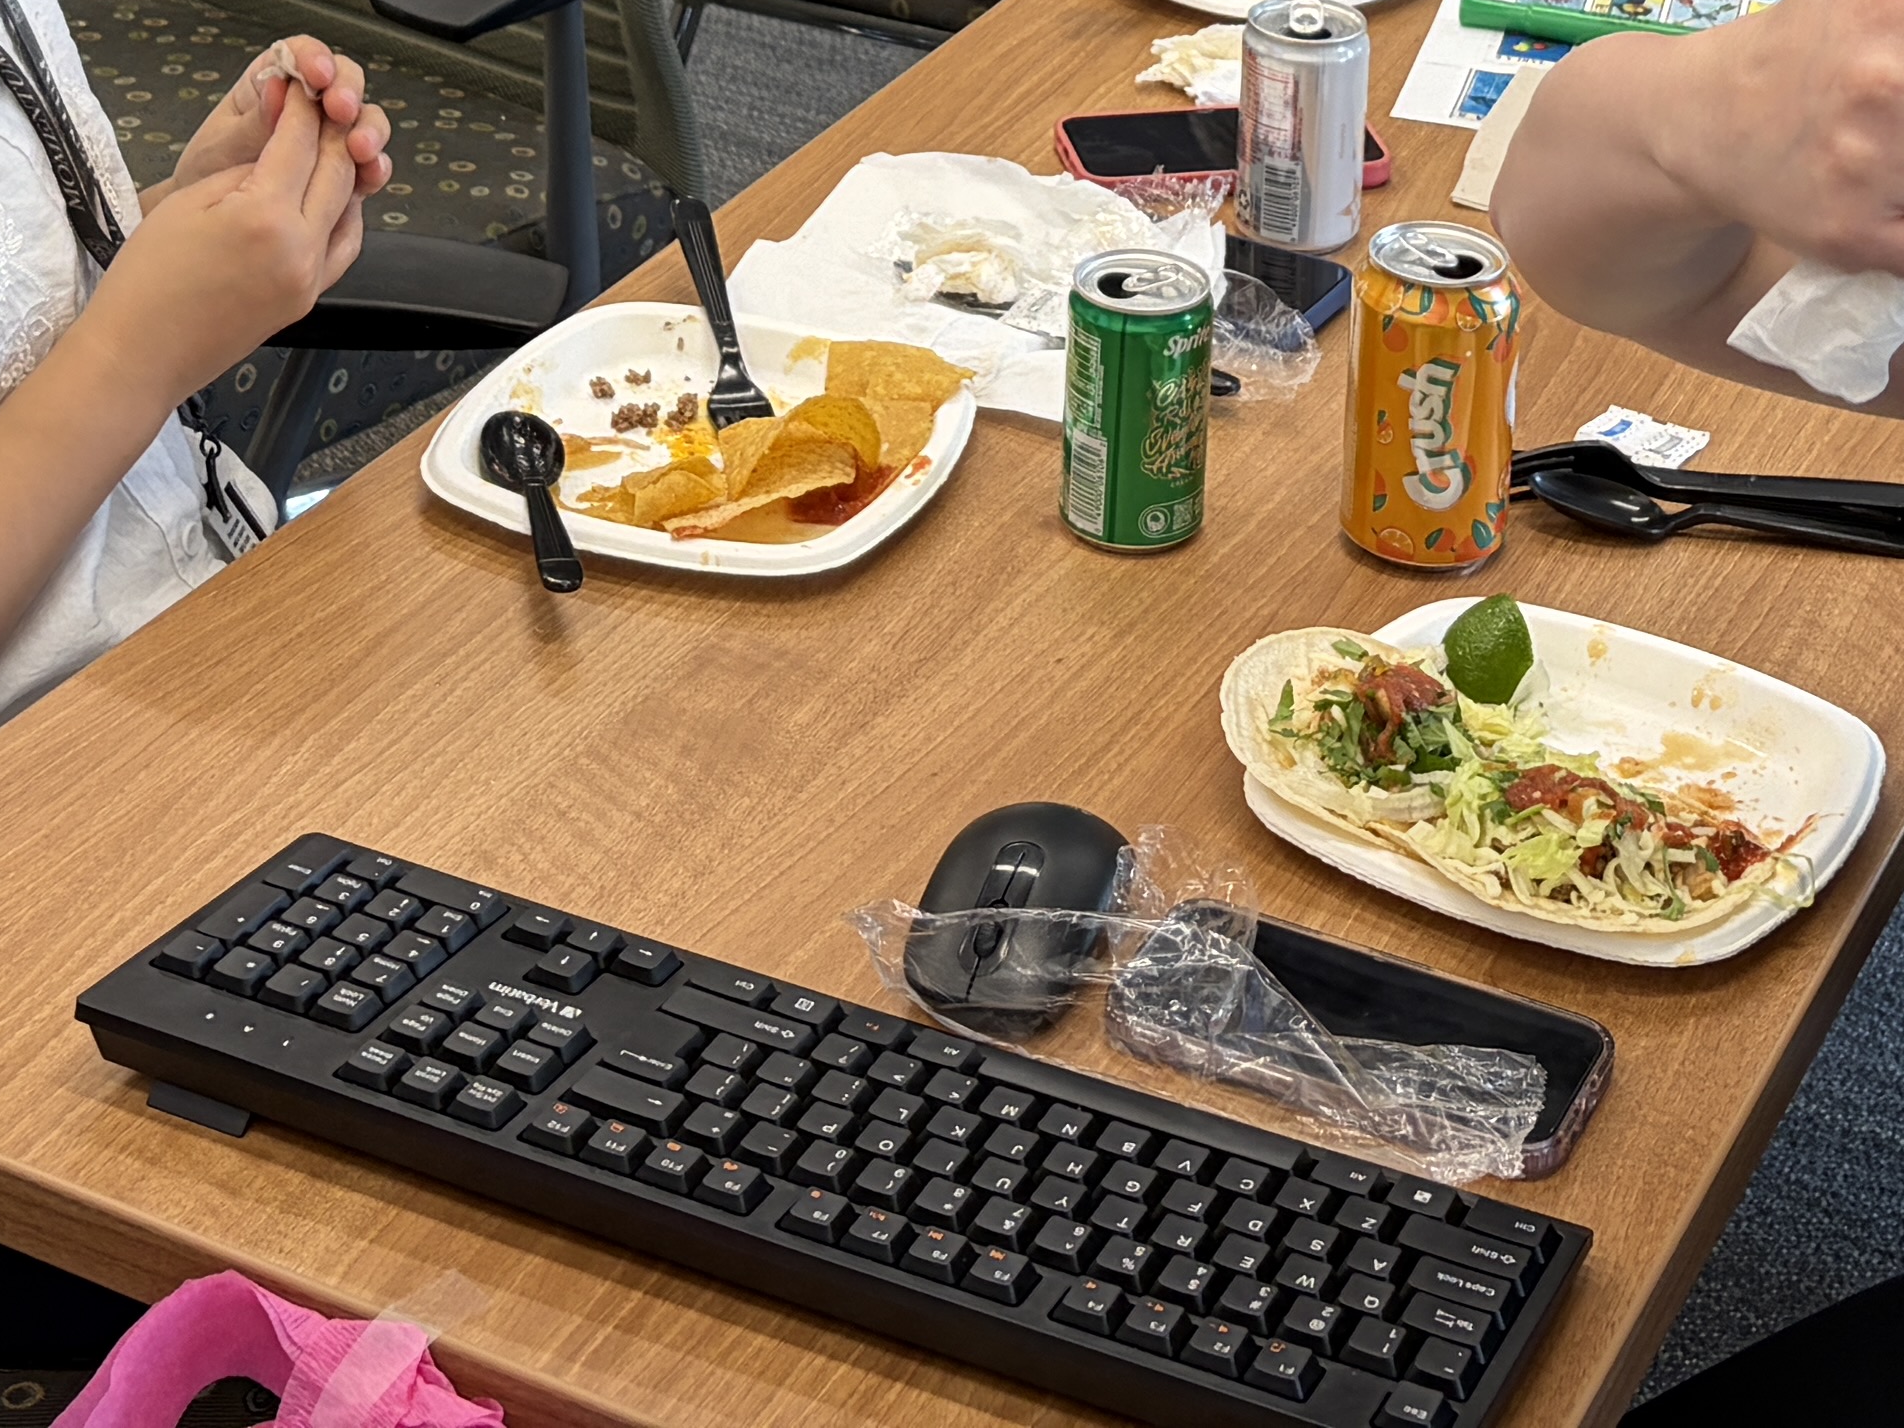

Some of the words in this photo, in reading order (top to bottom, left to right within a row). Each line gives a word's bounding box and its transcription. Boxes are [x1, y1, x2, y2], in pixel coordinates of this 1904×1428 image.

[1397, 358, 1471, 512] Crush
[470, 902, 480, 910] 0
[389, 908, 400, 916] 2
[357, 933, 369, 941] 5
[735, 981, 754, 989] Ctrl
[489, 982, 558, 1015] Verbatim
[900, 1108, 908, 1119] L
[1001, 1105, 1018, 1116] M
[548, 1121, 570, 1132] F12
[822, 1124, 837, 1133] P
[951, 1126, 965, 1136] K
[1062, 1124, 1077, 1135] N
[606, 1141, 626, 1151] F11
[879, 1140, 893, 1150] O
[1011, 1146, 1023, 1154] J
[1123, 1143, 1135, 1152] B
[661, 1159, 683, 1171] F10
[1067, 1162, 1082, 1174] H
[1178, 1161, 1190, 1171] V
[894, 1169, 905, 1177] 9
[996, 1178, 1010, 1189] U
[1126, 1181, 1140, 1192] G
[1240, 1180, 1254, 1189] C
[1055, 1197, 1067, 1207] Y
[1300, 1199, 1314, 1210] X
[1188, 1203, 1202, 1212] F
[1013, 1209, 1023, 1217] 7
[1117, 1218, 1128, 1228] T
[1249, 1221, 1263, 1231] D
[1362, 1218, 1376, 1229] Z
[872, 1232, 888, 1240] F7
[1177, 1236, 1192, 1246] R
[1311, 1240, 1324, 1250] S
[1240, 1256, 1254, 1268] E
[1374, 1259, 1387, 1270] A
[1197, 1267, 1207, 1275] 4
[1296, 1275, 1314, 1288] W
[1260, 1287, 1270, 1296] 3
[1088, 1301, 1103, 1310] F4
[1364, 1296, 1379, 1308] Q
[1322, 1307, 1334, 1316] 2
[1150, 1322, 1165, 1332] F3
[1390, 1329, 1396, 1338] 1
[1214, 1343, 1230, 1353] F2
[1280, 1365, 1294, 1374] F1
